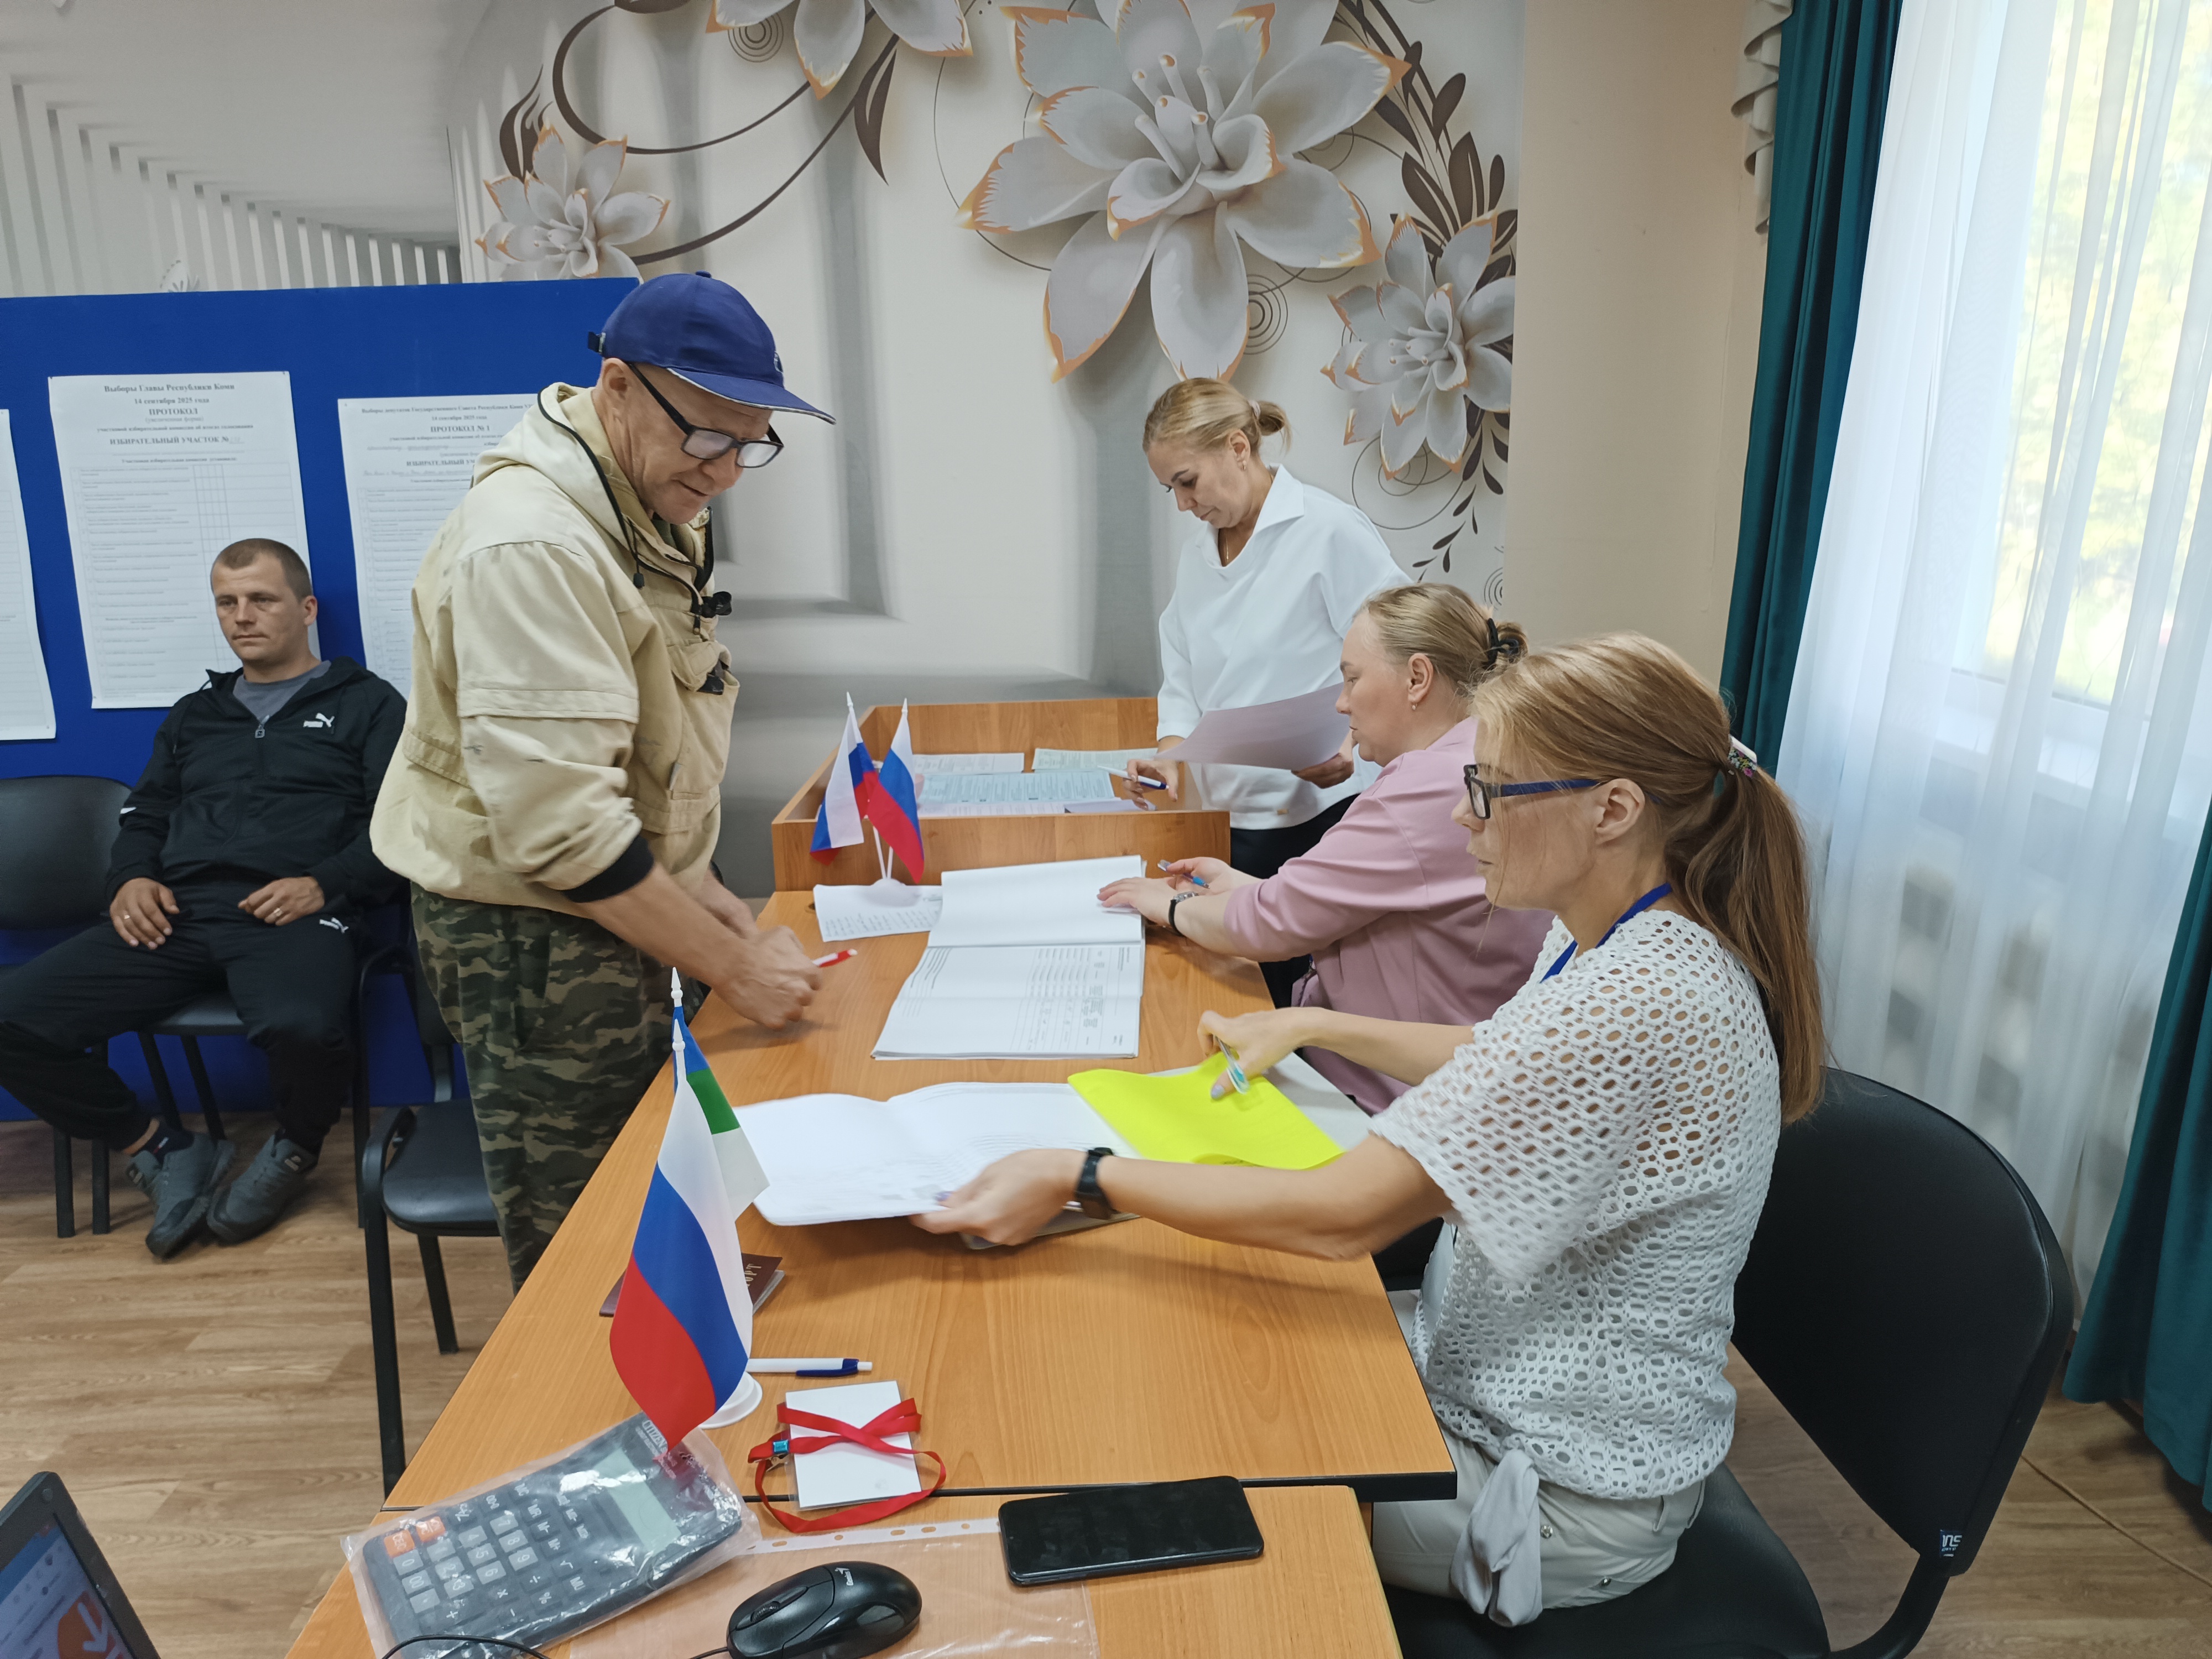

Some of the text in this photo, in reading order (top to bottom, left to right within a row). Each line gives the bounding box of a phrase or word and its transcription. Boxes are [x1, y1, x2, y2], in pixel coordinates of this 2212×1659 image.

[104, 385, 137, 393] Выборы
[166, 384, 212, 393] Республики
[149, 407, 198, 415] ПРОТОКОЛ
[109, 436, 179, 445] ИЗБИРАТЕЛЬНЫЙ
[641, 1420, 666, 1447] CITIZEN
[528, 1504, 541, 1518] MR
[508, 1537, 520, 1546] 8
[476, 1550, 489, 1559] 5
[517, 1554, 530, 1563] 9
[401, 1558, 415, 1567] 0
[485, 1568, 498, 1577] 6
[409, 1575, 424, 1589] 00
[570, 1577, 586, 1591] MU
